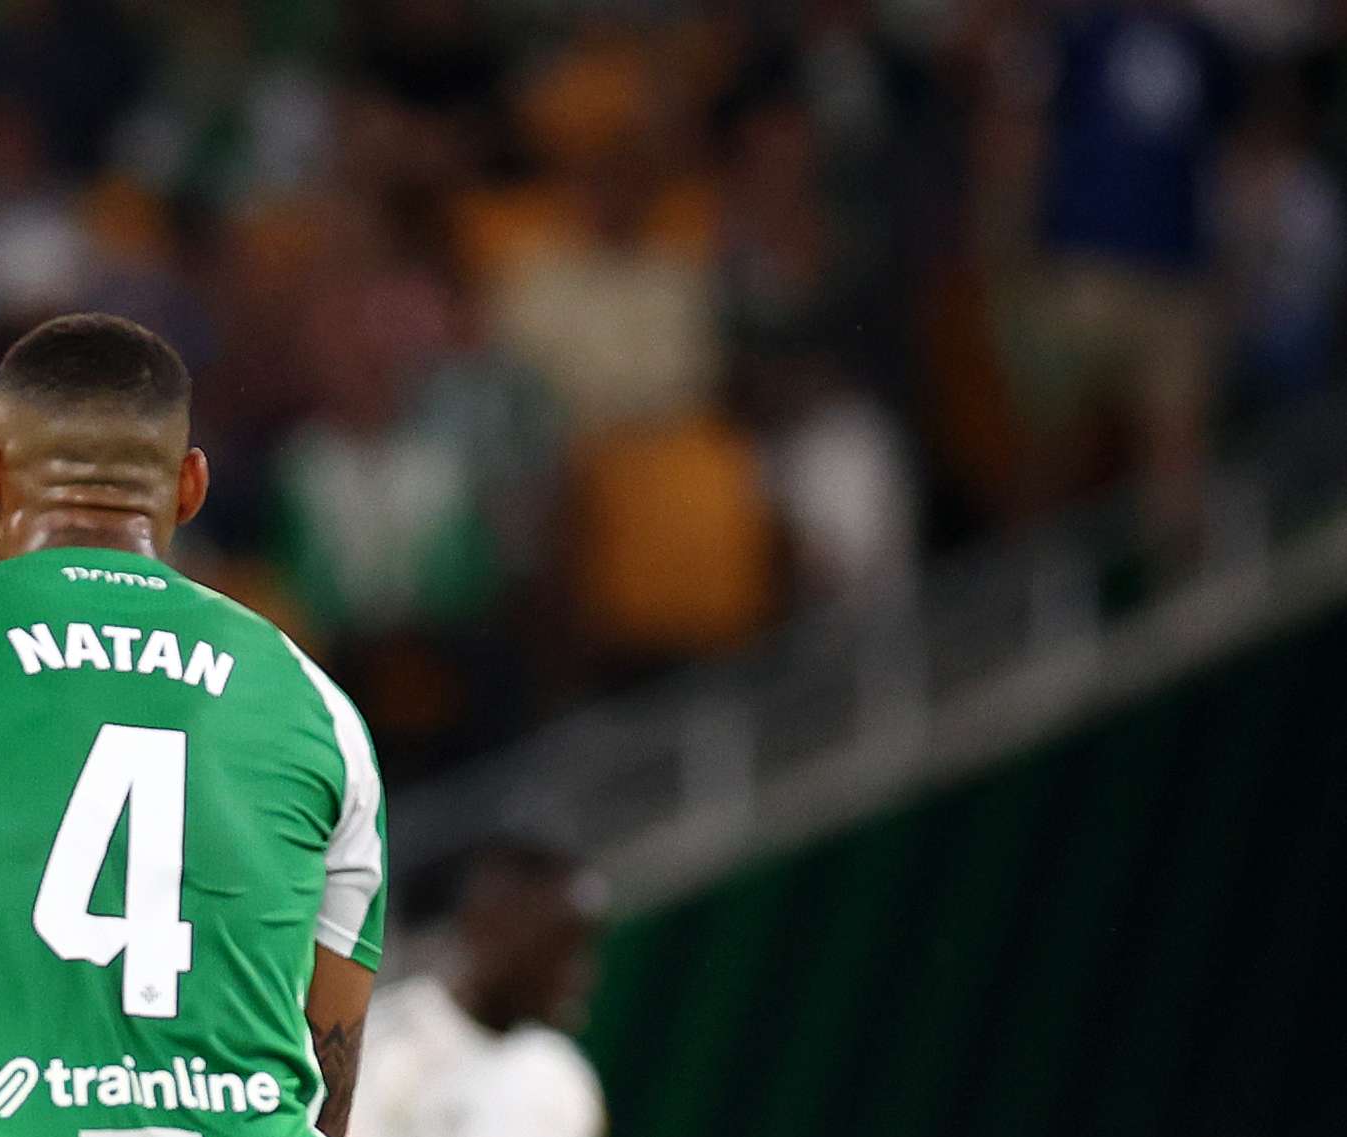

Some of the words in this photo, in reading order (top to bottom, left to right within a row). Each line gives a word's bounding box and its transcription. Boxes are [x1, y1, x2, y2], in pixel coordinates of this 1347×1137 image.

[7, 623, 235, 697] NATAN
[32, 722, 193, 1019] 4
[44, 1054, 281, 1112] trainline
